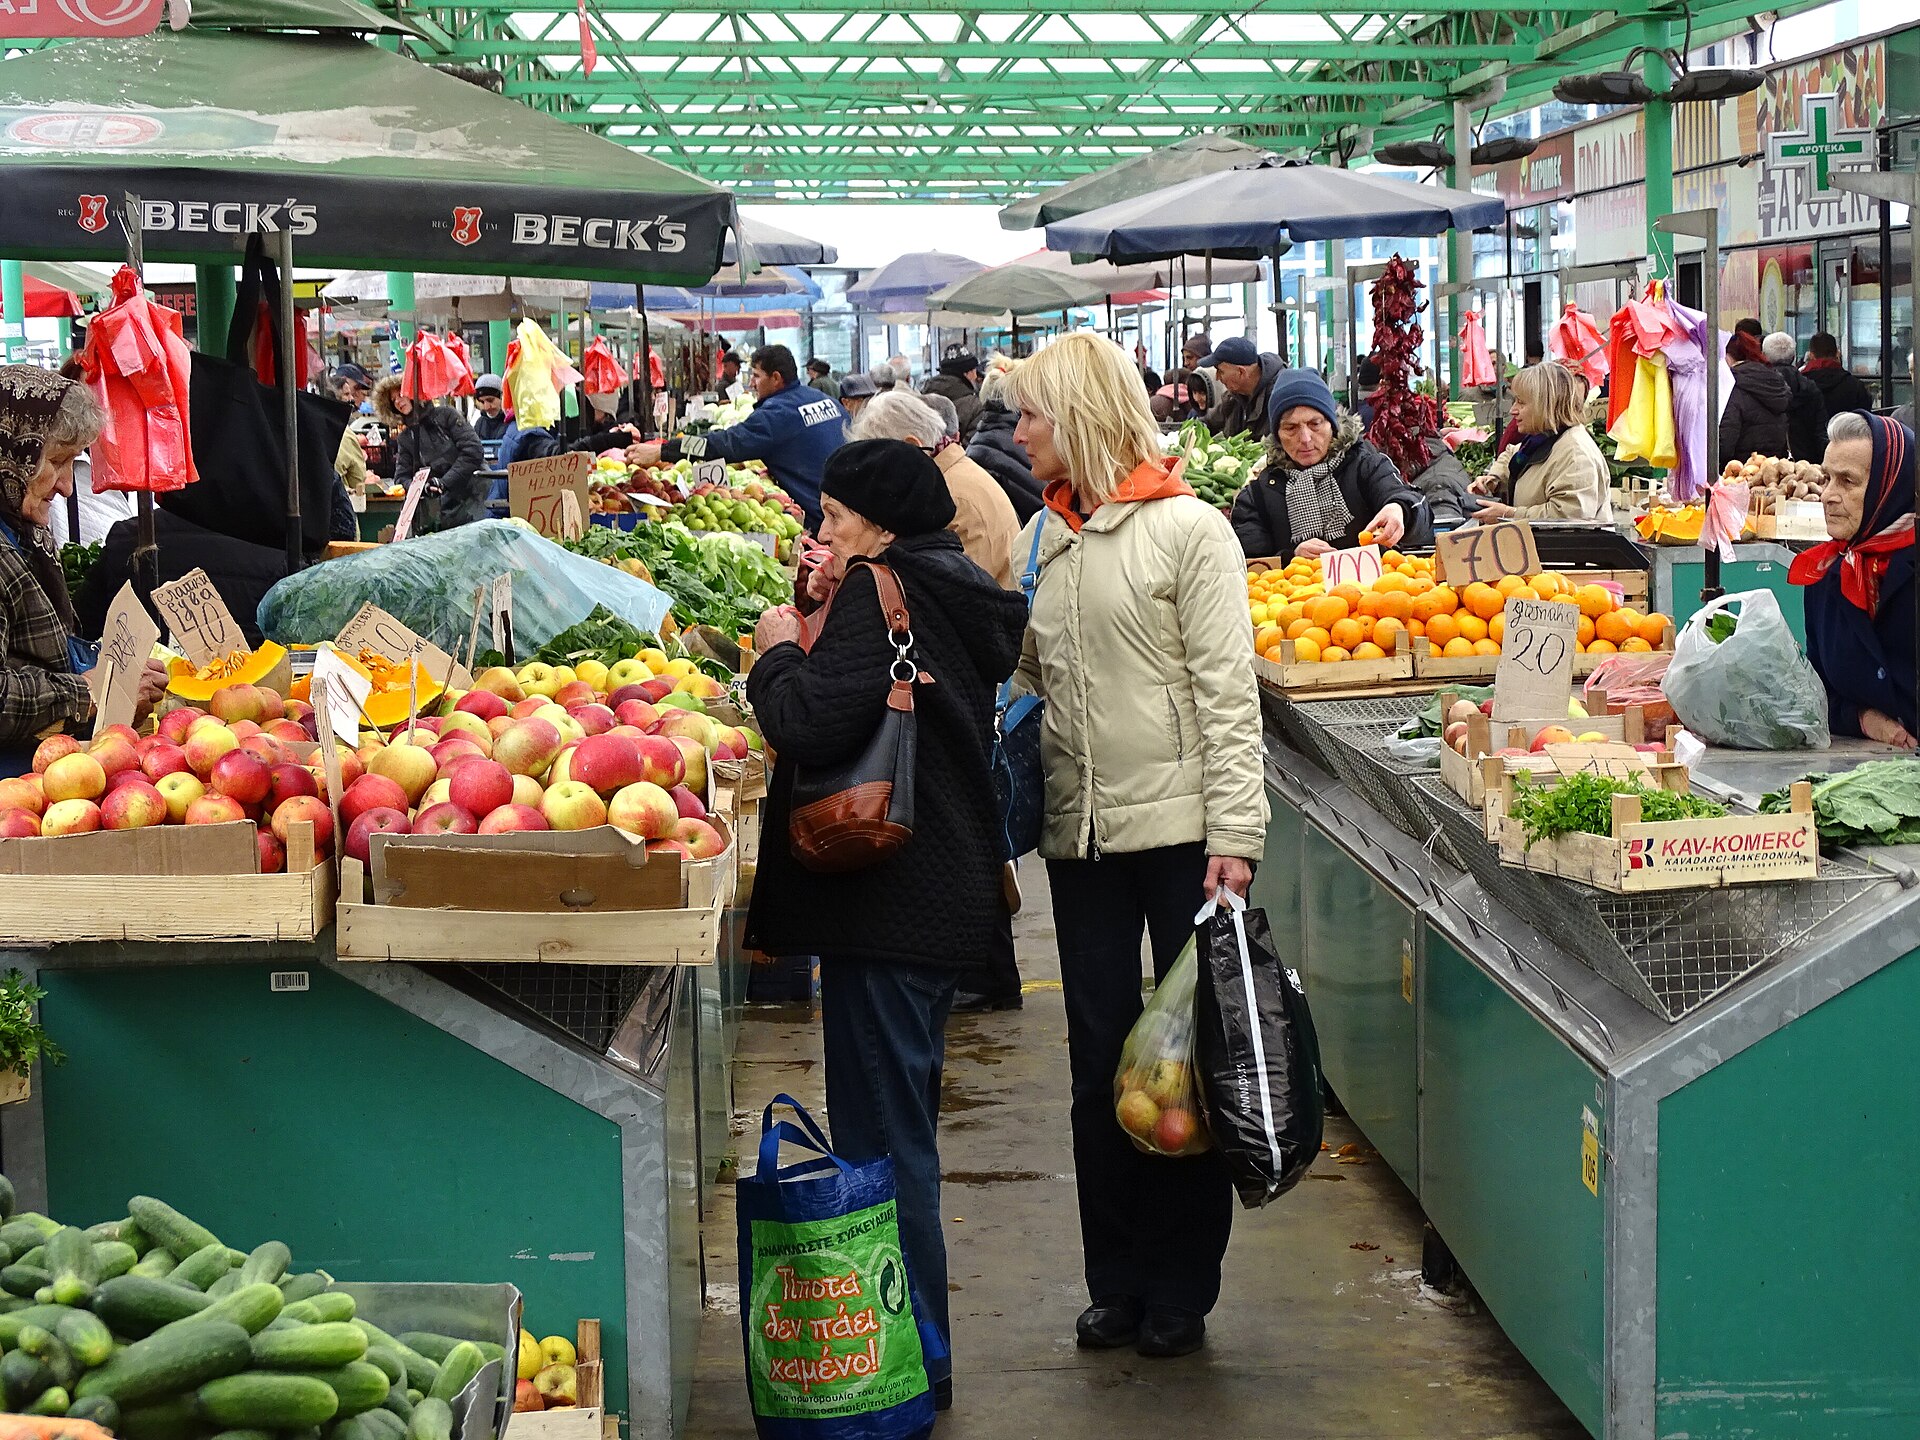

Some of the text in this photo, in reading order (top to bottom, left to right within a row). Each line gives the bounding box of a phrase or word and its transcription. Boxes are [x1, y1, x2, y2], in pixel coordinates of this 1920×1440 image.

[1798, 144, 1845, 154] APOTEKA
[58, 208, 75, 217] REG
[140, 198, 318, 236] BECK'S
[431, 212, 687, 253] REG TM BECK'S
[511, 454, 579, 478] PUTERICA
[699, 464, 725, 486] 50
[1327, 550, 1381, 586] 100
[1450, 523, 1529, 583] 70
[1511, 628, 1566, 676] 20
[1661, 829, 1807, 857] KAV-KOMERC
[1664, 851, 1801, 866] KAVADARCI-MAKEDONIJA
[1585, 1153, 1596, 1186] 105
[763, 1302, 880, 1341] δεν πάει
[769, 1338, 879, 1394] χαμένο!
[857, 1389, 874, 1397] του
[868, 1399, 886, 1409] της
